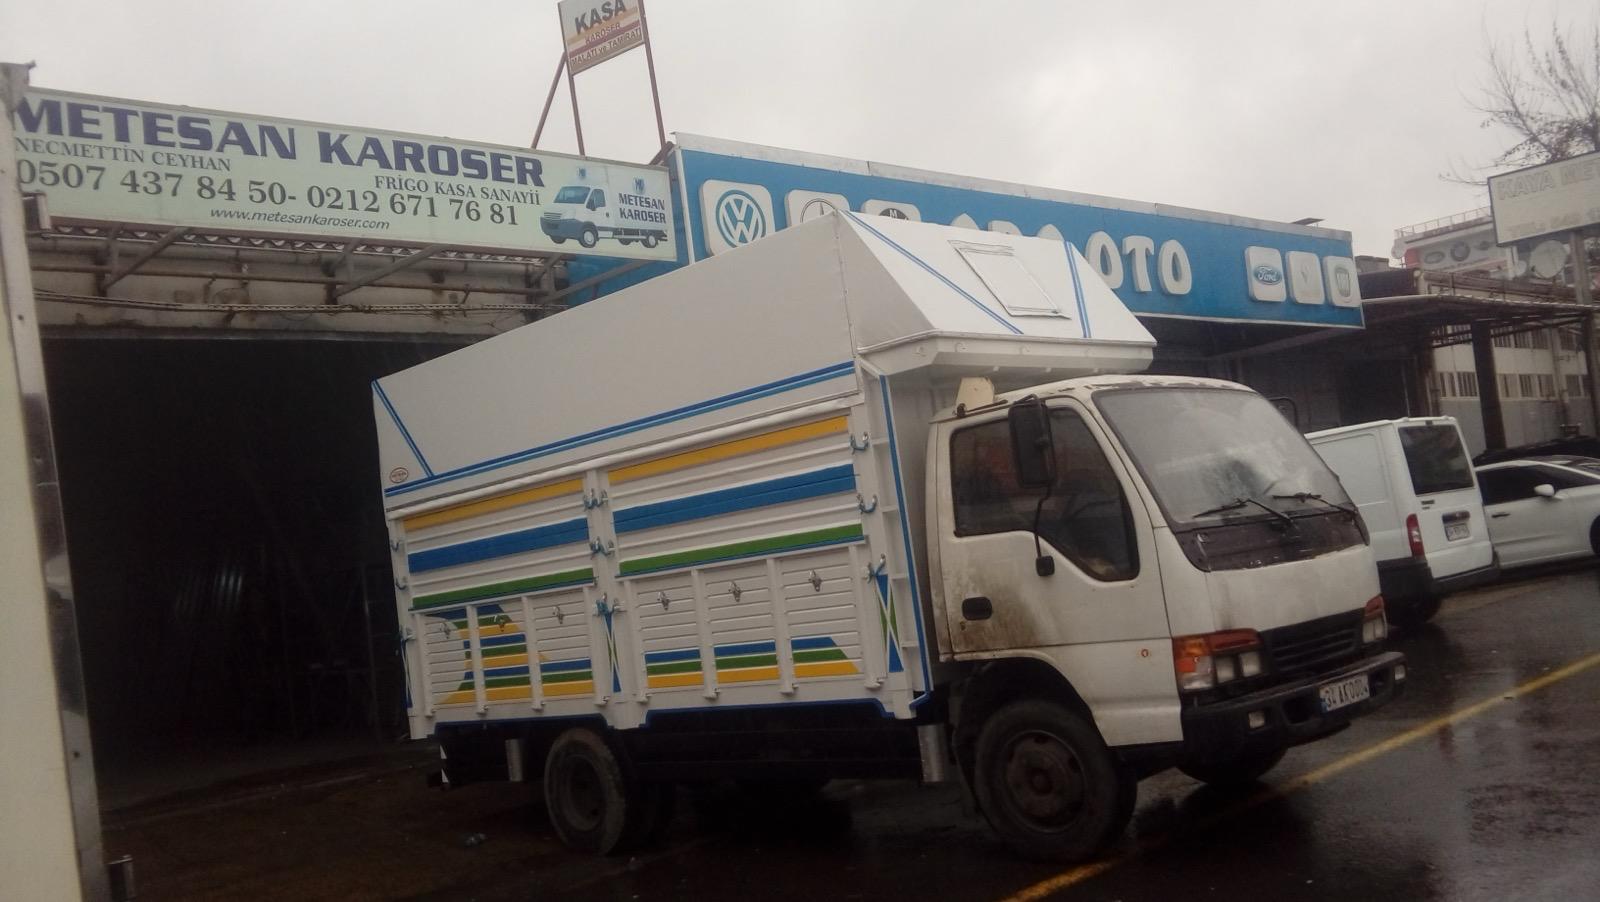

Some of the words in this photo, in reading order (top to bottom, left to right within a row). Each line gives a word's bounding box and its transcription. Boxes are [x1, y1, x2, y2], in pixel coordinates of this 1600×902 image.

[575, 0, 626, 34] KASA
[16, 97, 296, 159] METESAN
[317, 131, 545, 187] KAROSER
[16, 137, 144, 164] NECMETTİN
[152, 151, 231, 172] CEYHAN
[17, 159, 106, 191] 0507
[120, 170, 183, 197] 437
[197, 175, 236, 202] 84
[307, 184, 380, 214] 0212
[389, 193, 437, 219] 671
[448, 198, 481, 223] 76
[489, 201, 520, 226] 81
[375, 174, 429, 193] FRİGO
[435, 181, 476, 198] KASA
[618, 193, 665, 210] METESAN
[619, 208, 667, 223] KAROSER
[210, 208, 390, 230] www.metesankaroser.com
[1087, 230, 1192, 296] OTO
[1256, 266, 1277, 281] Ford
